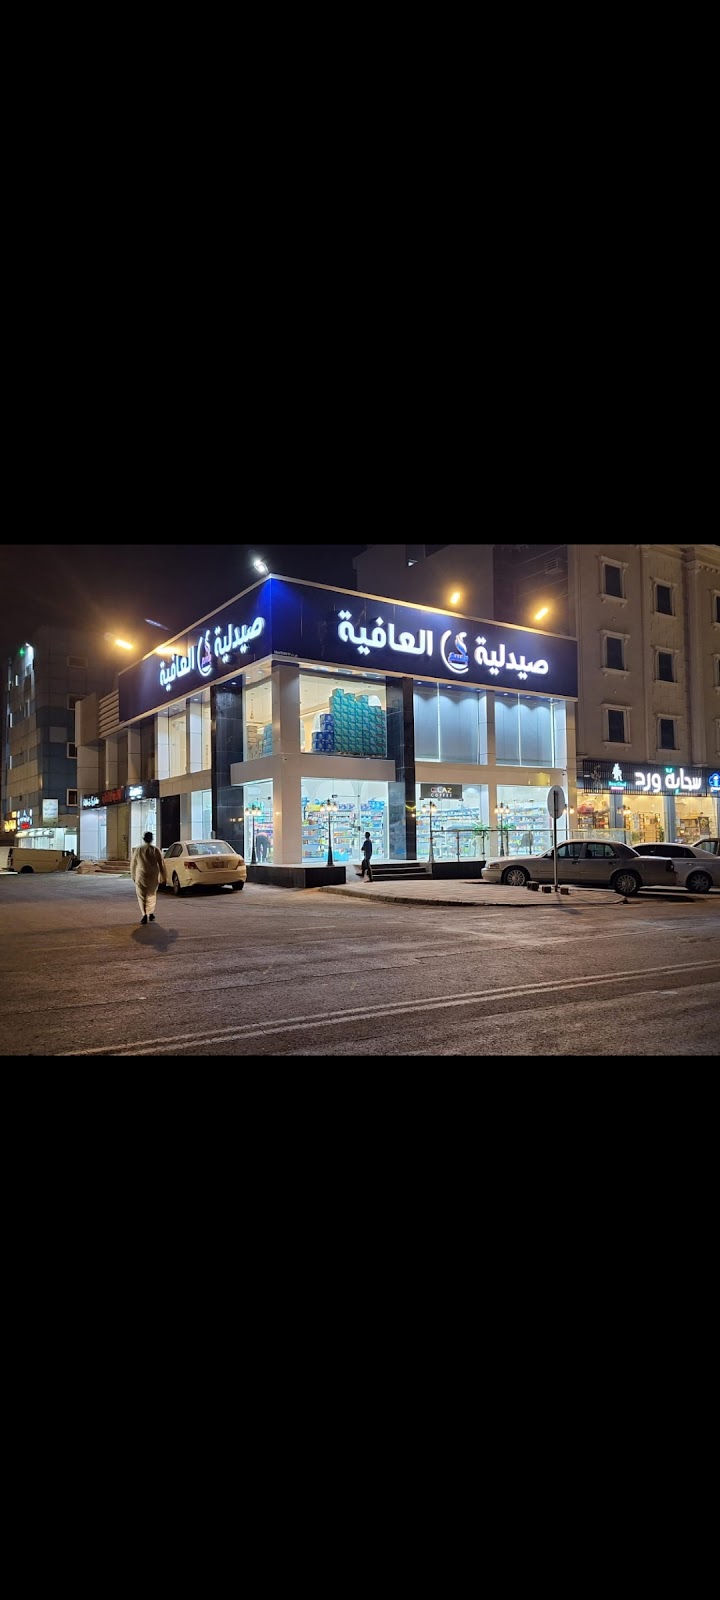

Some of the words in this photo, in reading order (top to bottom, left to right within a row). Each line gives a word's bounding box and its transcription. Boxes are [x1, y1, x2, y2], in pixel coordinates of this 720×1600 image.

[214, 616, 266, 664] صيدلية
[337, 609, 434, 656] العافية
[159, 645, 195, 692] العافية
[474, 636, 549, 680] صيدلية
[634, 771, 662, 793] ورد
[665, 767, 702, 795] سحابة
